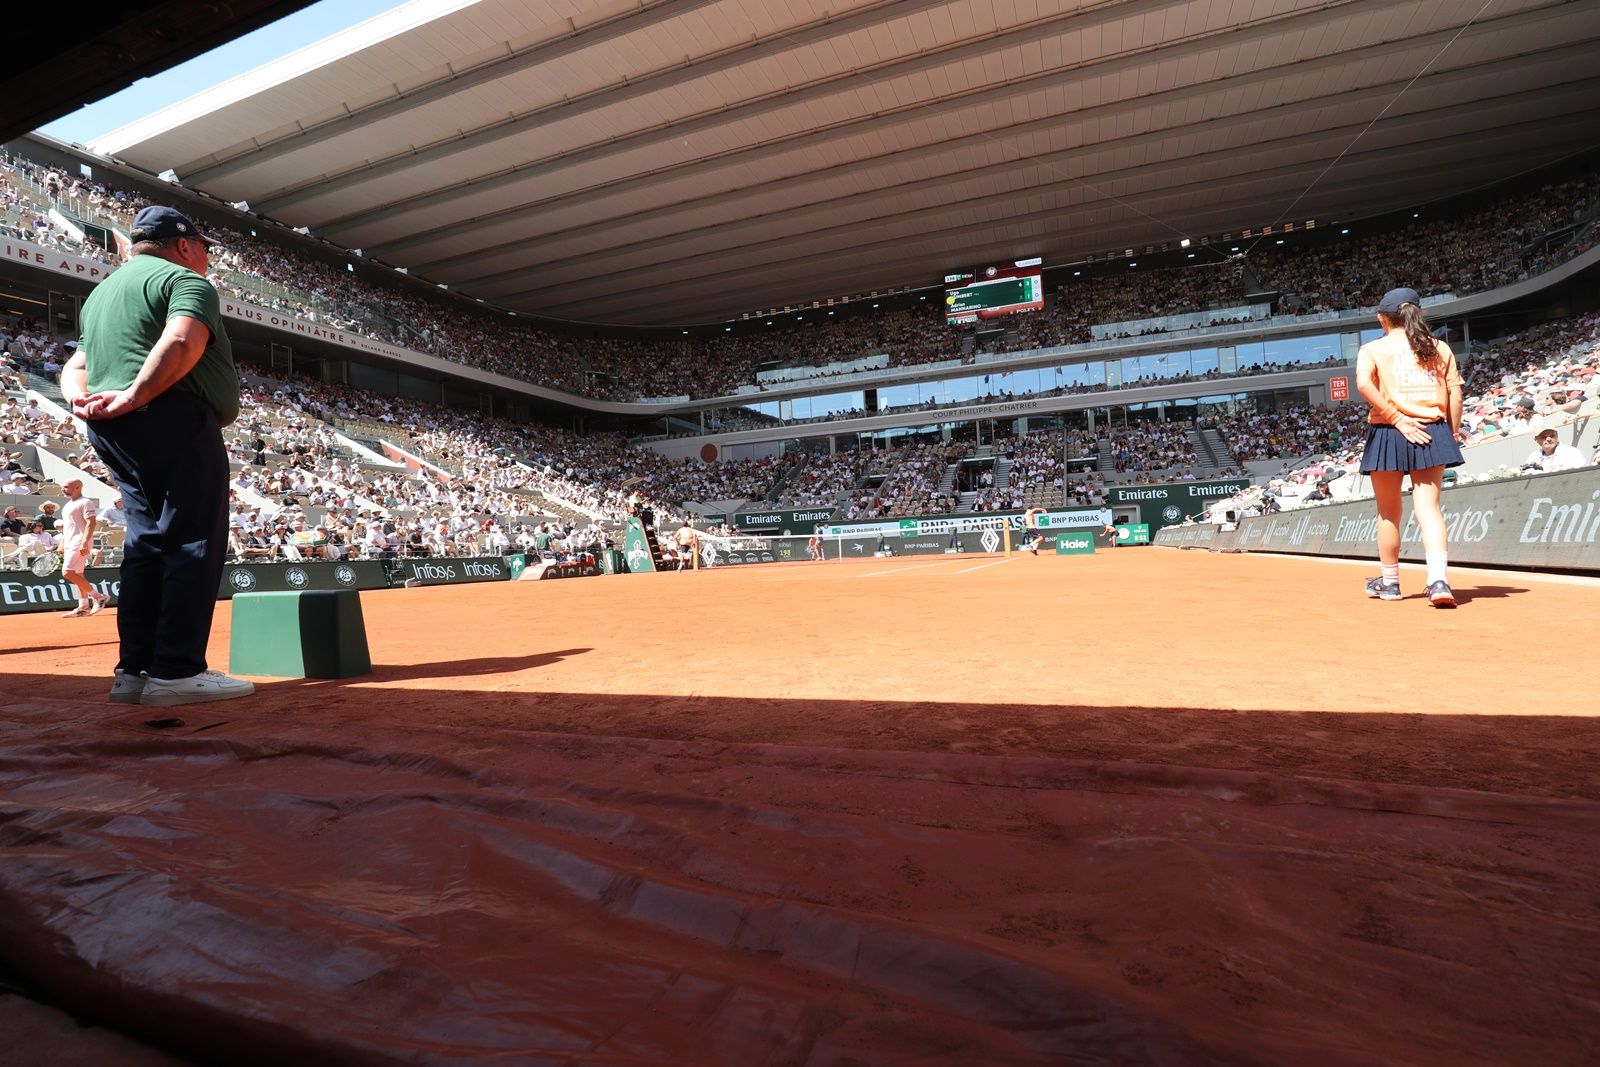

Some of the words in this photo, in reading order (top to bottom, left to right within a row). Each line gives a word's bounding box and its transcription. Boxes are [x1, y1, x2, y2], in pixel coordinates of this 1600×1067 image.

[6, 245, 45, 264] IRE
[950, 304, 982, 313] MANNARINO
[226, 304, 263, 321] PLUS
[271, 317, 345, 342] OPINIÂTRE
[1332, 380, 1345, 388] TEN
[932, 410, 957, 419] COURT
[959, 407, 992, 416] PHILIPPE
[999, 401, 1037, 412] CHATRIER
[1118, 488, 1168, 501] Emirates
[1188, 484, 1240, 497] Emirates
[746, 514, 782, 525] Emirates
[793, 511, 830, 522] Emirates
[1051, 516, 1067, 524] BNP
[1068, 514, 1100, 523] PARIBAS
[921, 521, 949, 534] BNP
[1306, 523, 1330, 535] ACCOR
[1060, 540, 1089, 549] Haier
[412, 563, 456, 581] Infosys
[462, 561, 501, 578] Infosys
